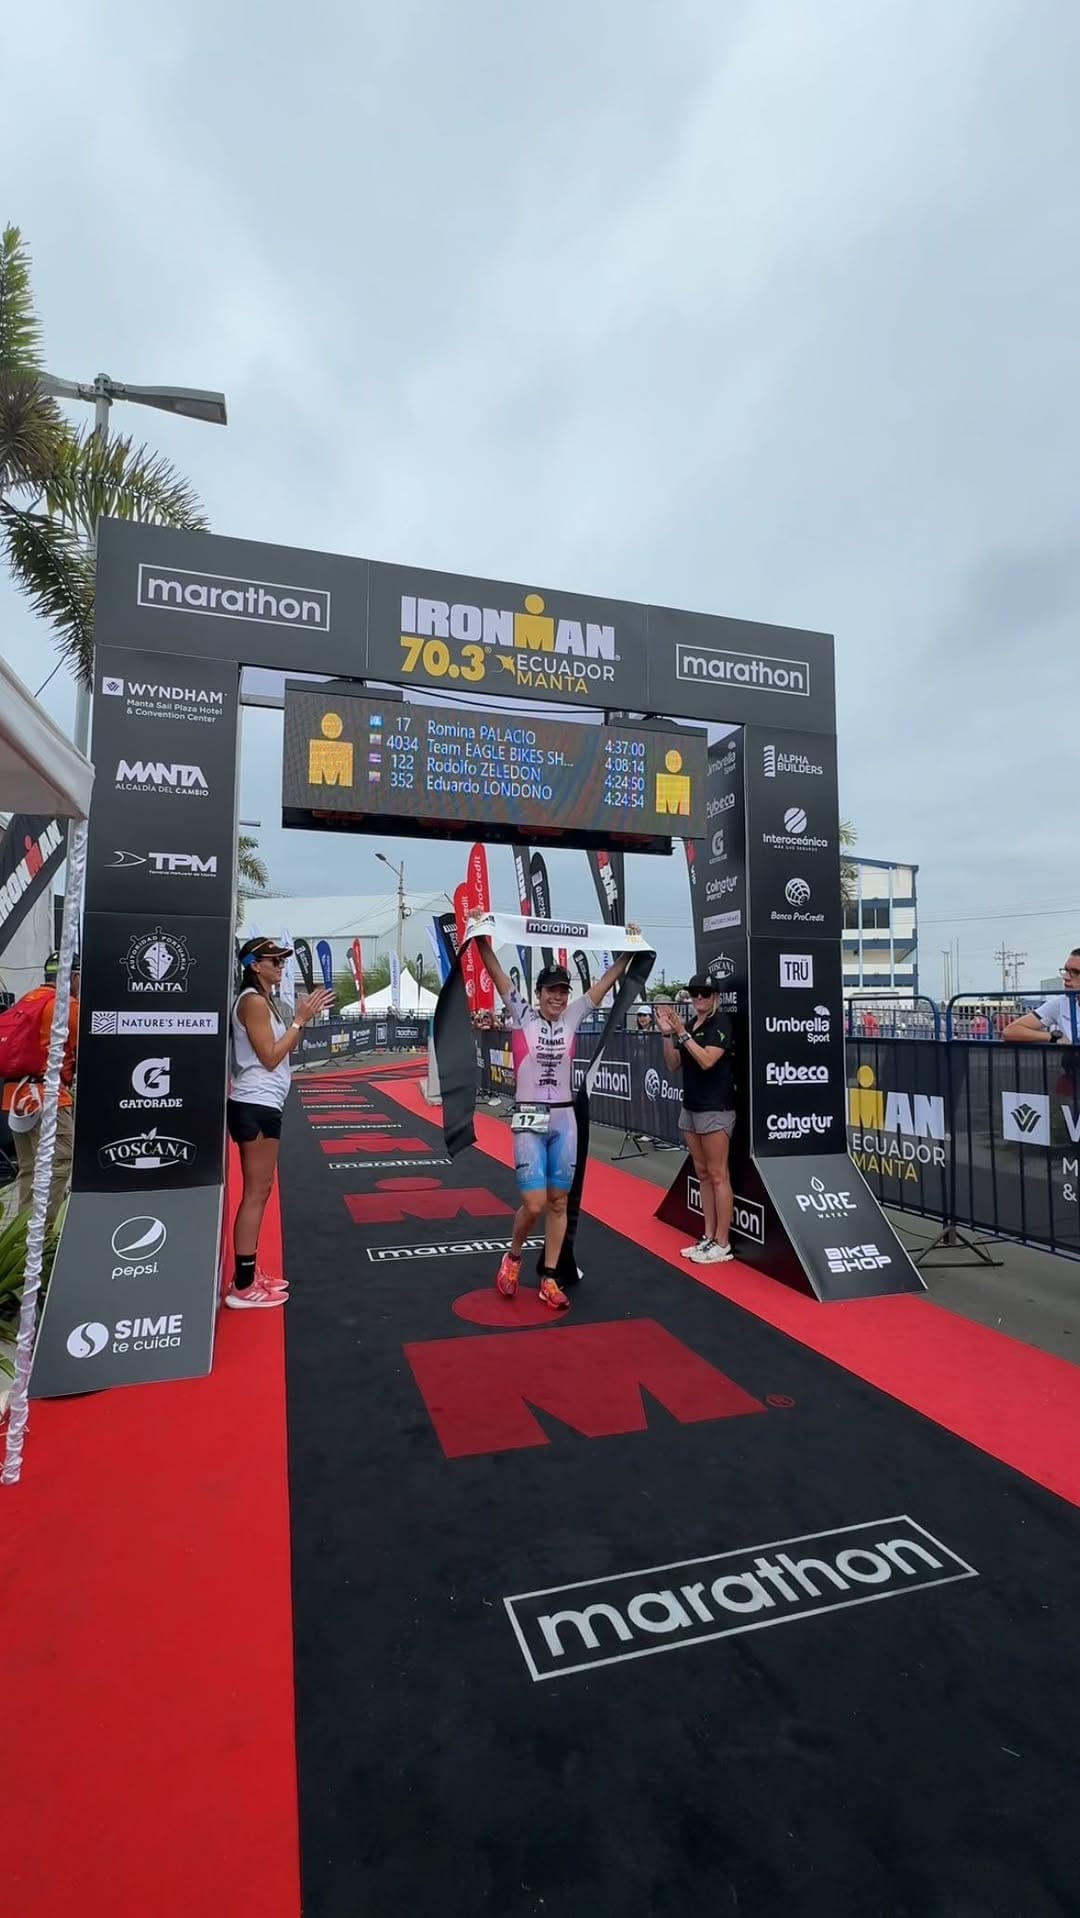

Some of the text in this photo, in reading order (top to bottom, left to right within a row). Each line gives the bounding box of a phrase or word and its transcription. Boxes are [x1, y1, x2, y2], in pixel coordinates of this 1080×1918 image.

[148, 578, 322, 623] marathon
[401, 594, 615, 660] IRONMAN
[400, 636, 486, 681] 70.3
[516, 654, 615, 682] ECUADOR
[683, 655, 803, 688] marathon
[128, 682, 223, 704] WYNDHAM
[516, 671, 589, 694] MANTA
[126, 707, 216, 723] & Convention Center
[127, 699, 223, 715] Manta Sail Plaza Hotel
[396, 717, 645, 757] 17 Romina PALACIO 4:37:00
[386, 734, 419, 751] 4034
[427, 739, 461, 756] Team
[466, 743, 505, 760] EAGLE
[510, 747, 544, 764] BIKES
[605, 757, 645, 774] 4:08:14
[777, 753, 809, 765] ALPHA
[116, 760, 208, 788] MANTA
[391, 754, 645, 791] 122 Rodolfo ZELEDON 4:24:50
[777, 762, 823, 775] BUILDERS
[158, 785, 173, 793] DEL
[175, 787, 209, 796] CAMBIO
[390, 772, 644, 808] 352 Eduardo LONDONO 4:24:54
[763, 833, 828, 847] Interoceánica
[148, 852, 217, 873] TPM
[0, 819, 64, 928] RONMAN
[771, 911, 825, 923] Banco ProCredit
[529, 922, 586, 935] marathon
[784, 958, 809, 981] TRÜ
[131, 982, 183, 992] MANTA
[121, 1018, 173, 1028] NATURE'S
[766, 1017, 830, 1032] Umbrella
[807, 1032, 830, 1044] Sport
[574, 1067, 685, 1101] mathon Banc
[766, 1061, 829, 1086] Fybeca
[119, 1098, 183, 1108] GATORADE
[519, 1115, 535, 1126] 17
[767, 1113, 833, 1133] Colnatur
[104, 1140, 189, 1162] TOSCANA
[852, 1133, 946, 1167] ECUADOR
[852, 1152, 919, 1182] MANTA
[795, 1192, 857, 1212] PURE
[824, 1244, 881, 1260] BIKE
[112, 1262, 158, 1279] pepsi
[827, 1255, 892, 1273] SHOP
[114, 1314, 183, 1340] SIME
[112, 1335, 181, 1353] te cuida
[537, 1536, 944, 1656] marathon
